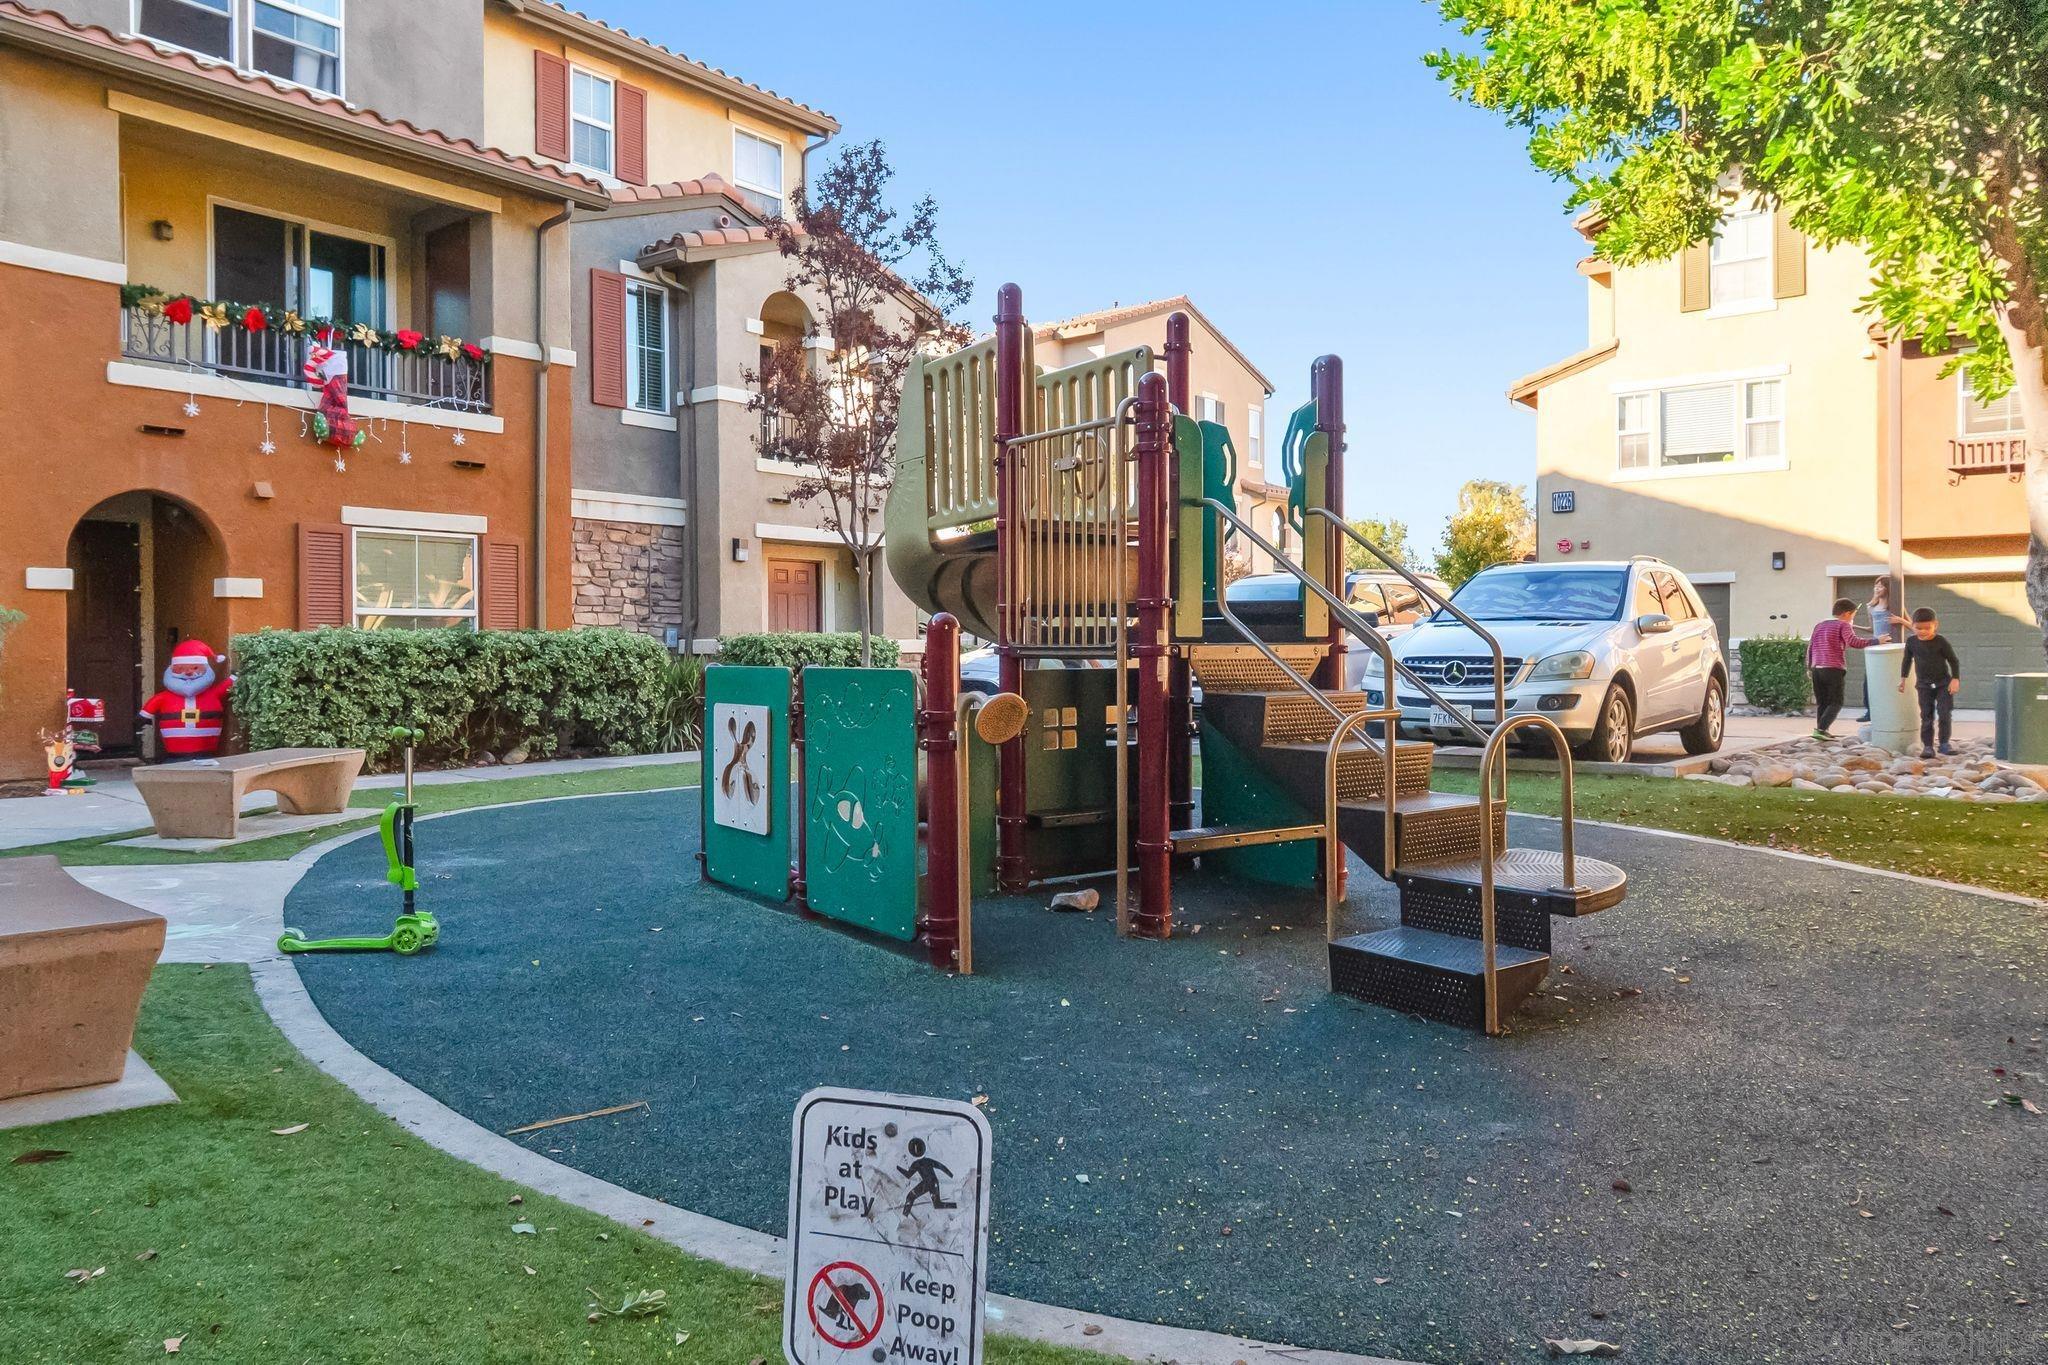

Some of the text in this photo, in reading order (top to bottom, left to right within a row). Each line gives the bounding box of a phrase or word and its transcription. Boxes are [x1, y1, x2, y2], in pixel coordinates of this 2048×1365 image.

[826, 1124, 878, 1151] Kids
[838, 1159, 863, 1180] at
[824, 1186, 875, 1218] Play
[900, 1271, 956, 1304] Keep
[897, 1303, 955, 1338] Poop
[890, 1336, 959, 1365] Away!
